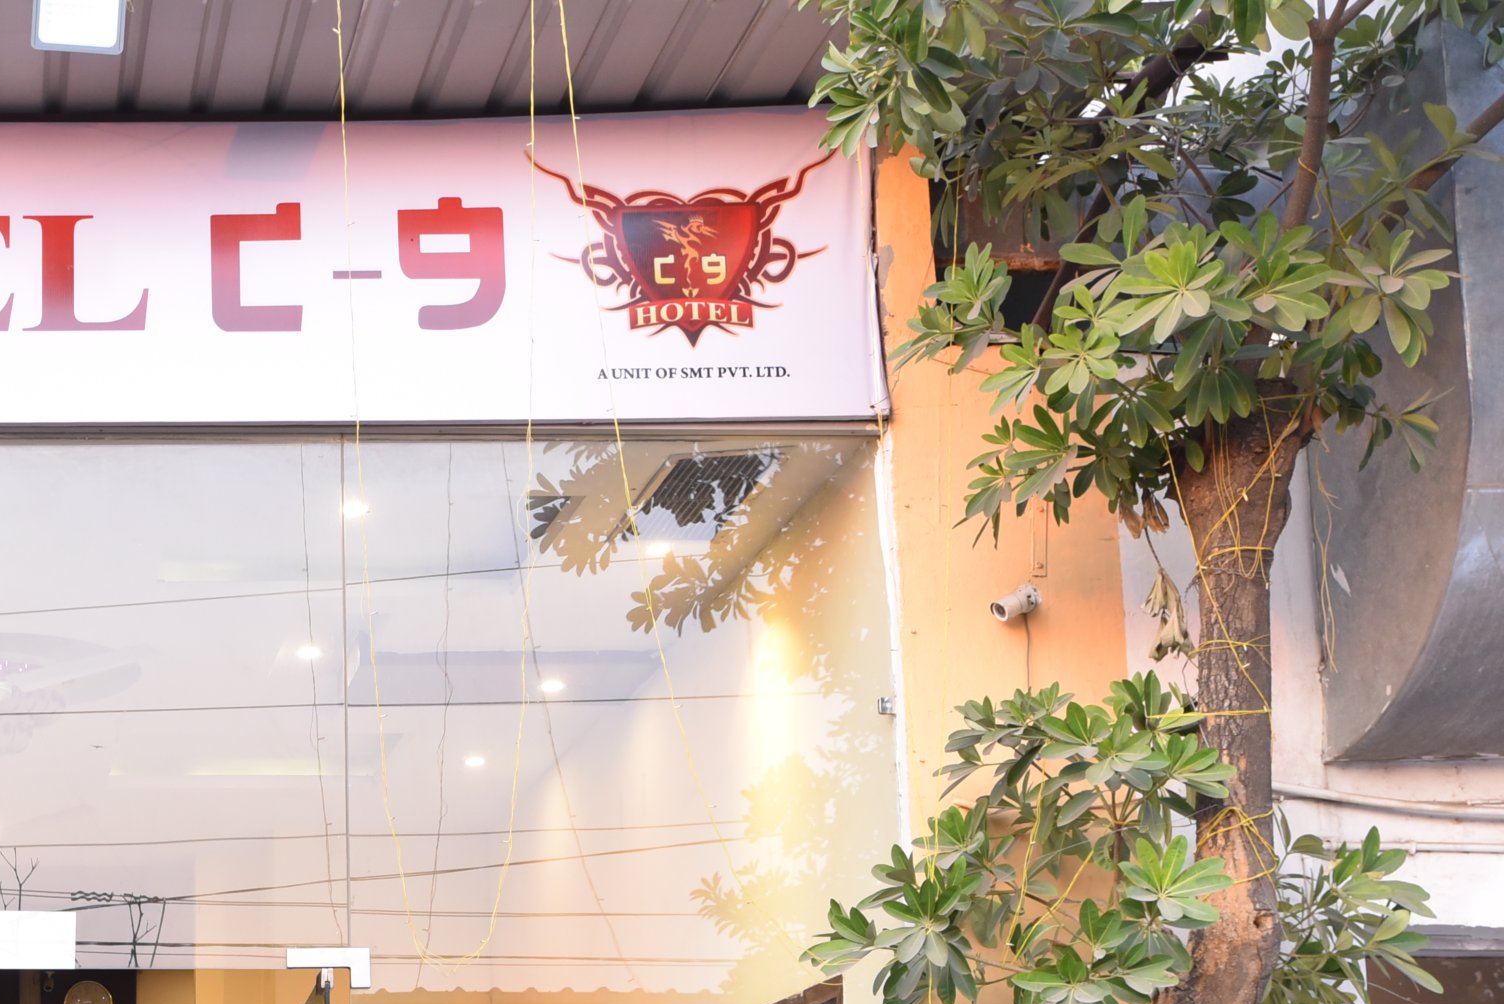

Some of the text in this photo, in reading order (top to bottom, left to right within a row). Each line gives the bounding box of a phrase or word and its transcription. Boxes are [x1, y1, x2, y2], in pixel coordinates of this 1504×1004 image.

[653, 253, 727, 285] C 9
[634, 301, 750, 327] HOTEL
[597, 366, 791, 380] A UNIT OF SMT PVT. LTD.
